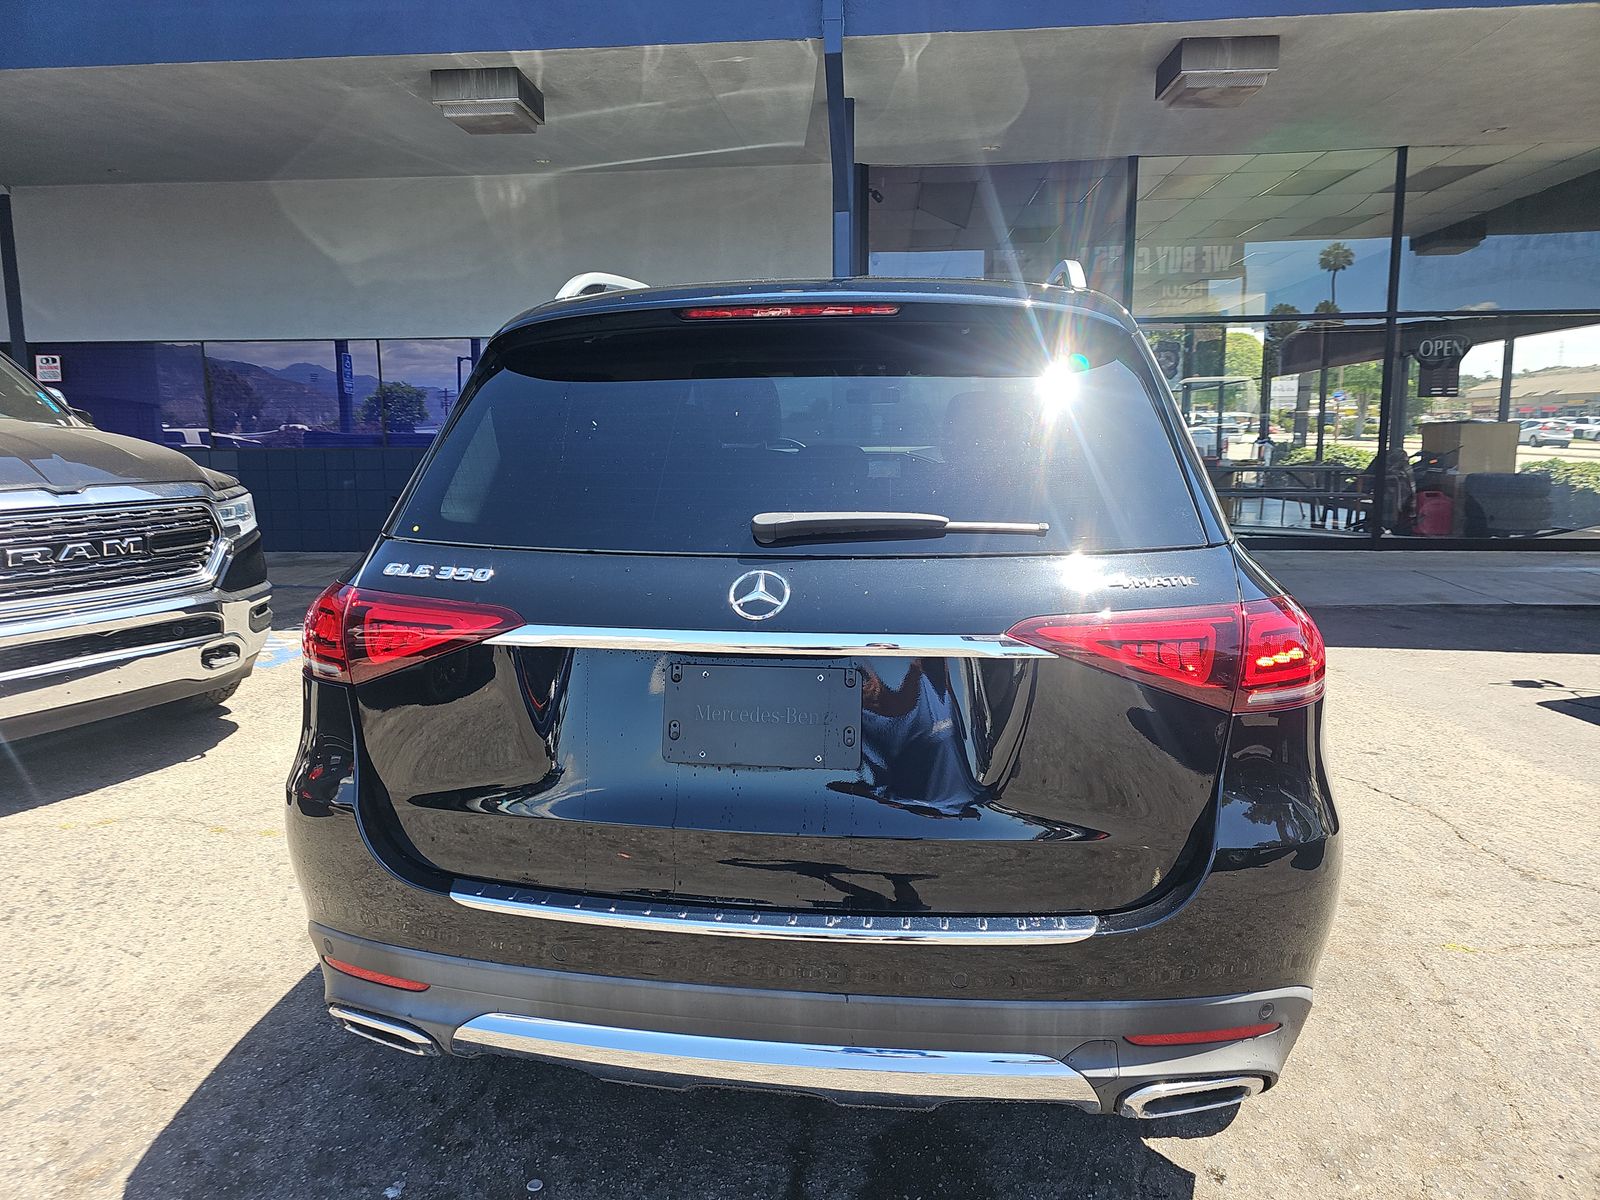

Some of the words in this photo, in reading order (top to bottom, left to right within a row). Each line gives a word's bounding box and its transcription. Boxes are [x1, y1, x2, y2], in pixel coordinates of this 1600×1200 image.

[1419, 340, 1464, 357] OPEN
[6, 537, 143, 567] RAM
[383, 562, 434, 578] GLE
[435, 565, 495, 582] 350
